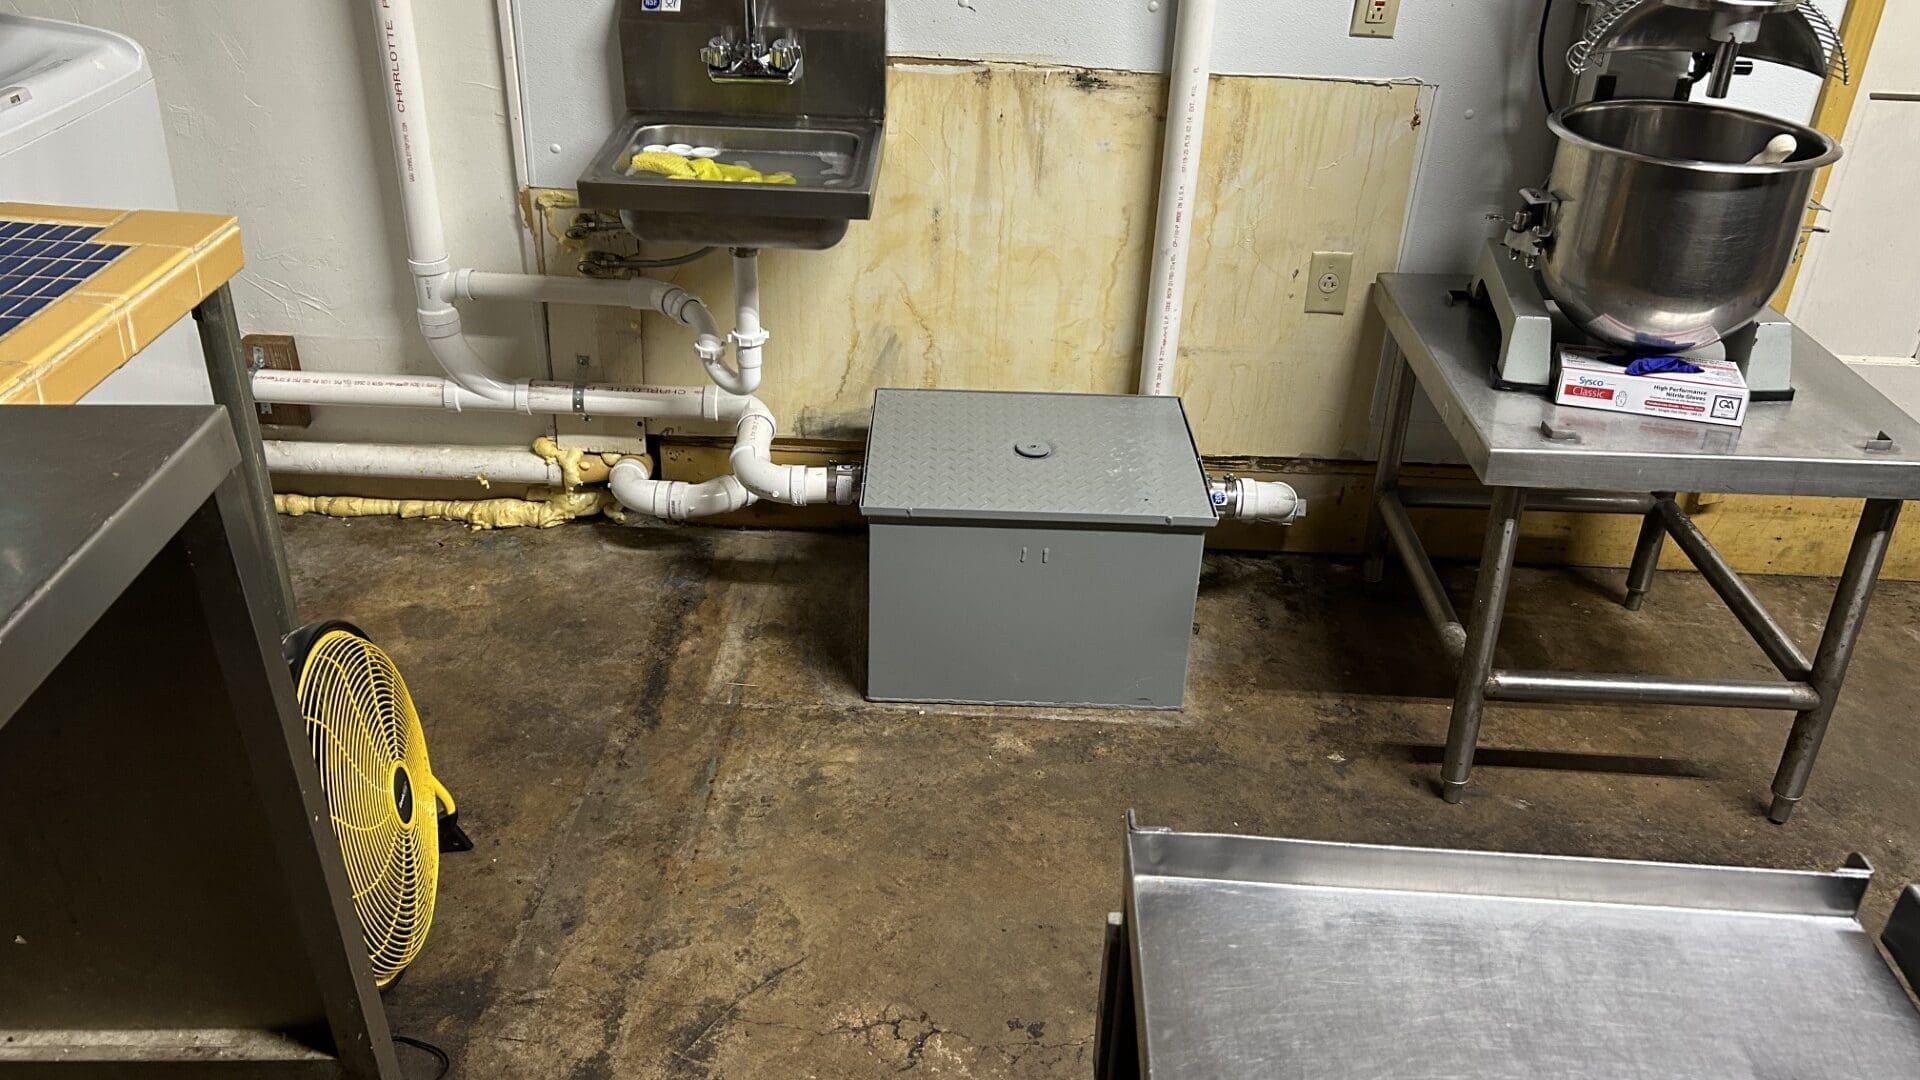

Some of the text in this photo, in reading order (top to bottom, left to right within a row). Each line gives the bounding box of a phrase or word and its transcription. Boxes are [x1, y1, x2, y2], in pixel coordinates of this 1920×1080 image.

[384, 20, 405, 113] CHARLOTTE
[1578, 376, 1604, 386] Sysco
[607, 386, 686, 395] CHARLOTTE
[1572, 386, 1605, 398] Classic
[1670, 386, 1708, 395] Performance
